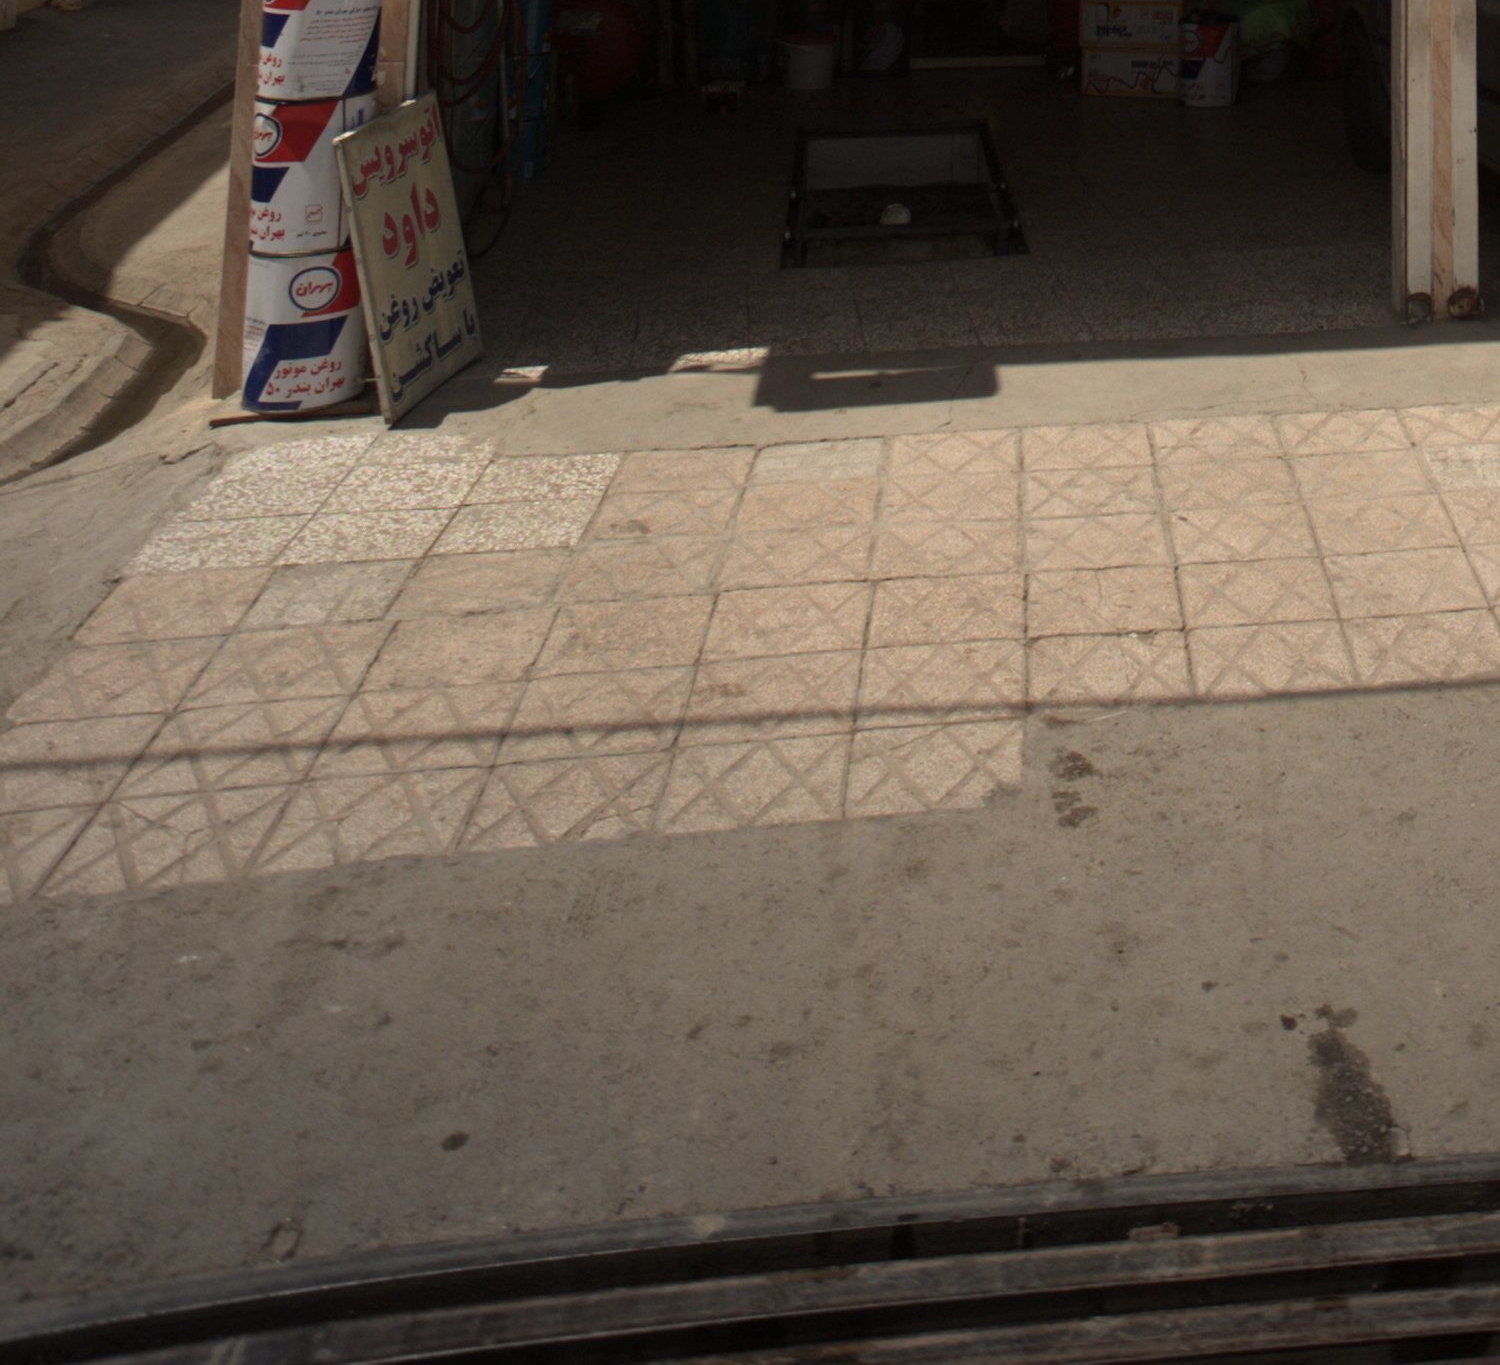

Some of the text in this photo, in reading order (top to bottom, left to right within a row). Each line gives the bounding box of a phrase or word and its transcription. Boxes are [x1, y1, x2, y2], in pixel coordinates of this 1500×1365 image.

[382, 181, 442, 270] داود
[379, 250, 466, 342] تعویض روغن
[265, 376, 345, 399] بهران بندر ۵۰
[274, 358, 342, 380] روغن موتور
